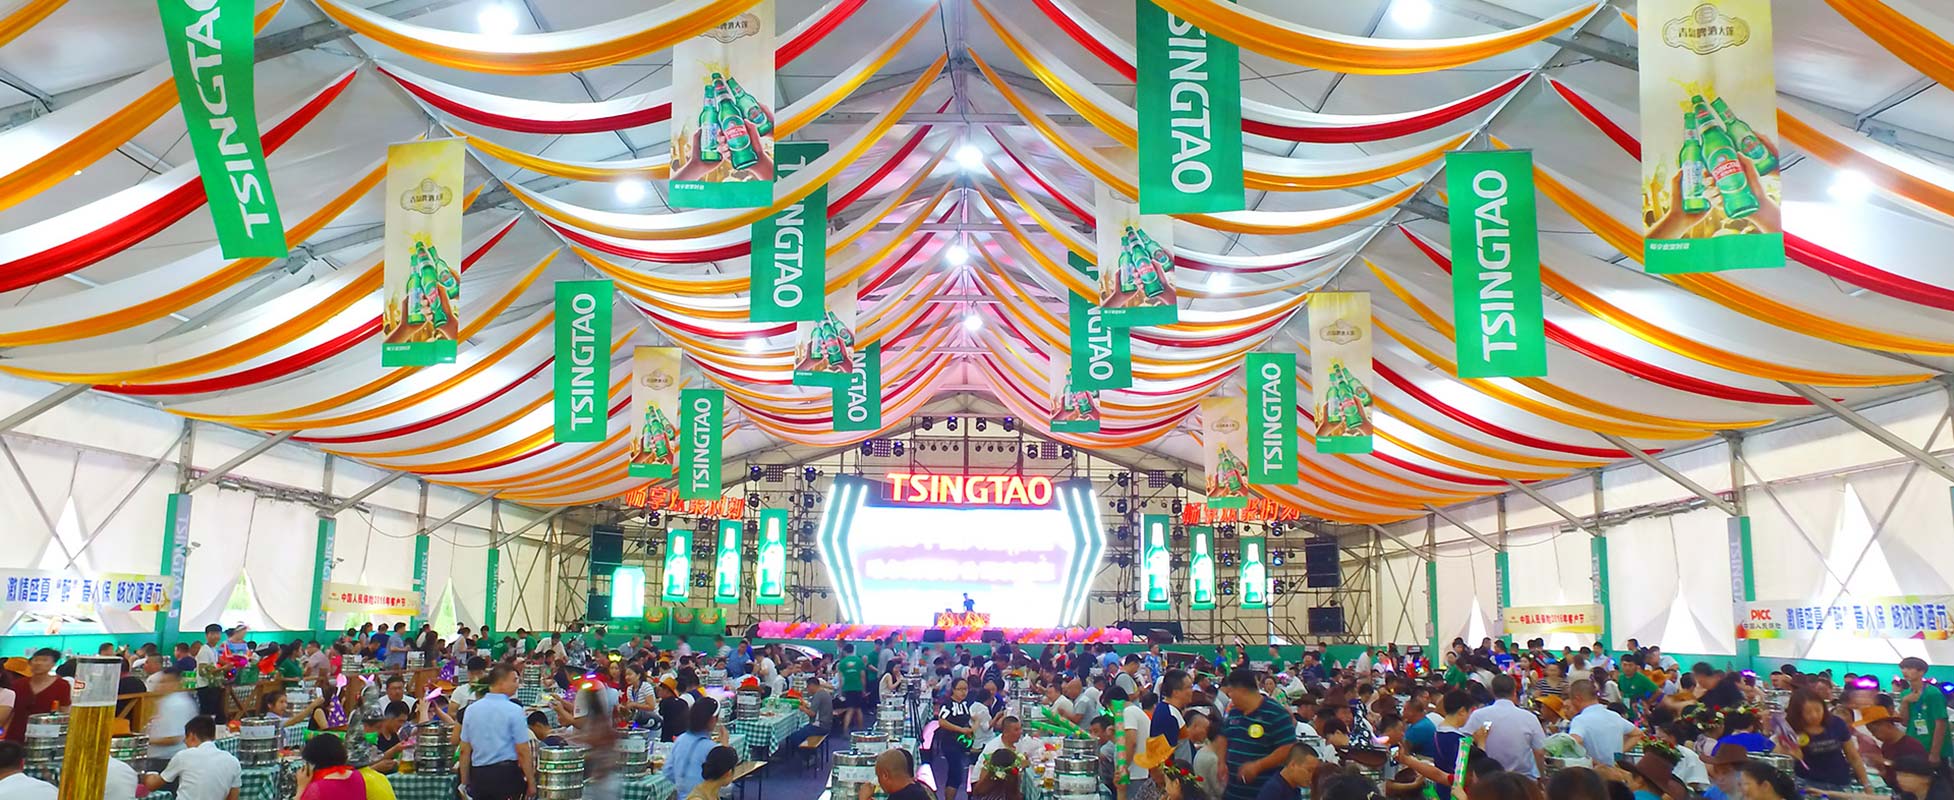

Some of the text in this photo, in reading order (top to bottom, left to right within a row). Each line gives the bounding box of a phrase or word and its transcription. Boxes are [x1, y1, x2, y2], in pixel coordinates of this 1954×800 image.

[1167, 12, 1213, 194] SINGTAO
[772, 155, 808, 308] TNGTAO
[1472, 169, 1518, 363] TSINGTAO
[571, 293, 597, 432] TSINGTAO
[1261, 362, 1284, 475] TSINGTAO
[692, 397, 712, 493] TSINGTAO
[887, 473, 1053, 506] TSINGTAO
[1751, 609, 1772, 621] PICC
